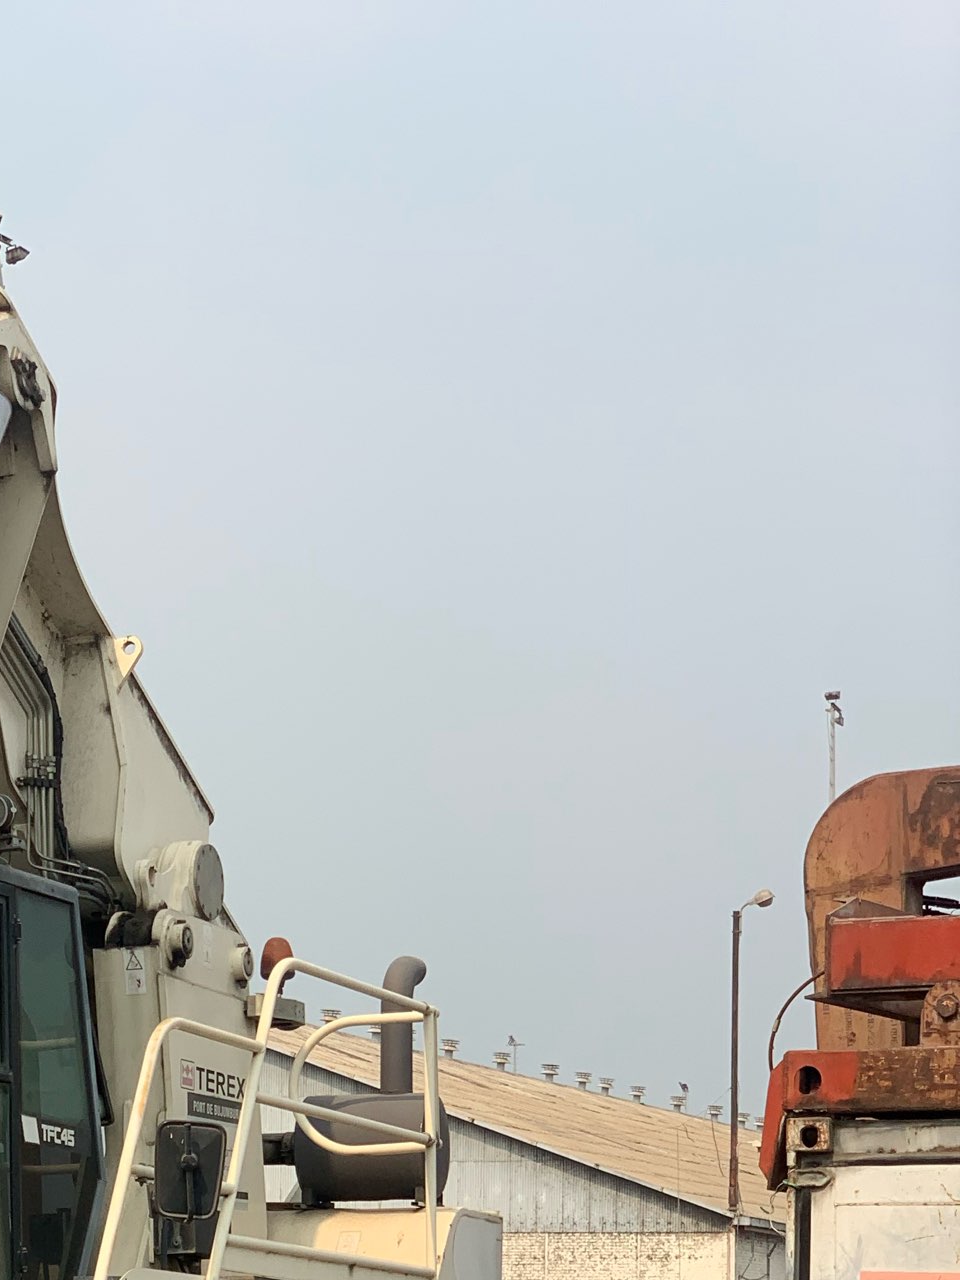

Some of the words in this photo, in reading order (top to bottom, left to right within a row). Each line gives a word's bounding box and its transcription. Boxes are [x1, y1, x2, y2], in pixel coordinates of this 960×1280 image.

[196, 1066, 246, 1099] TEREX
[193, 1100, 206, 1113] PORT
[207, 1103, 214, 1115] DE
[41, 1123, 75, 1147] TFC45
